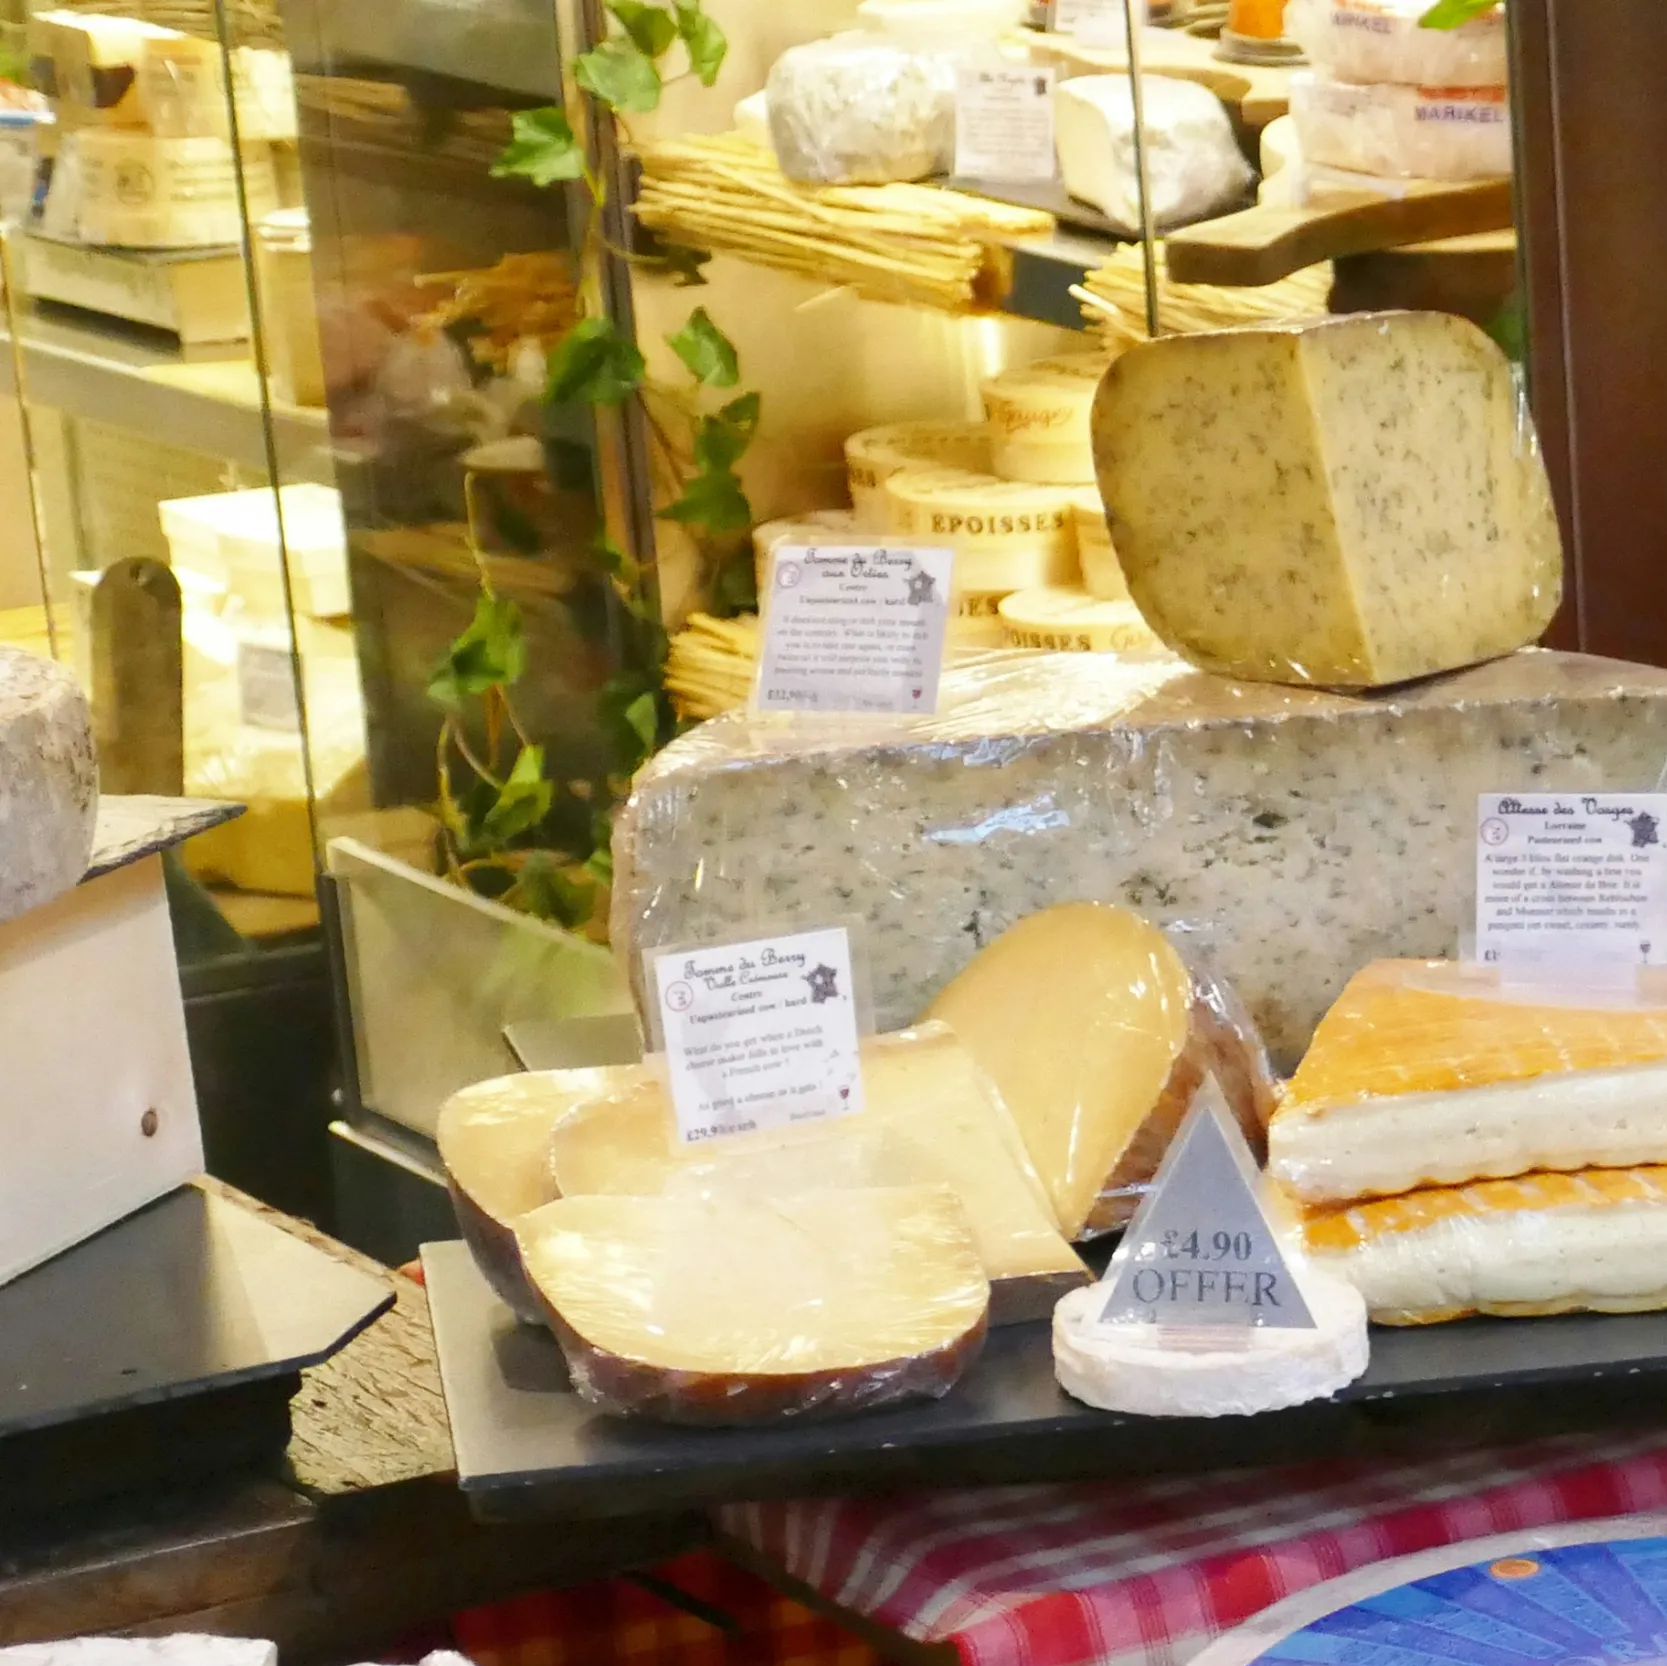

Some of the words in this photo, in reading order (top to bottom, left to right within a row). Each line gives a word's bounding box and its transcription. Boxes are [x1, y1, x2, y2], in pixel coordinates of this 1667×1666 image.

[931, 511, 1064, 535] EPOISSES
[1162, 1226, 1253, 1266] £4.90
[1131, 1267, 1283, 1310] OFFER
